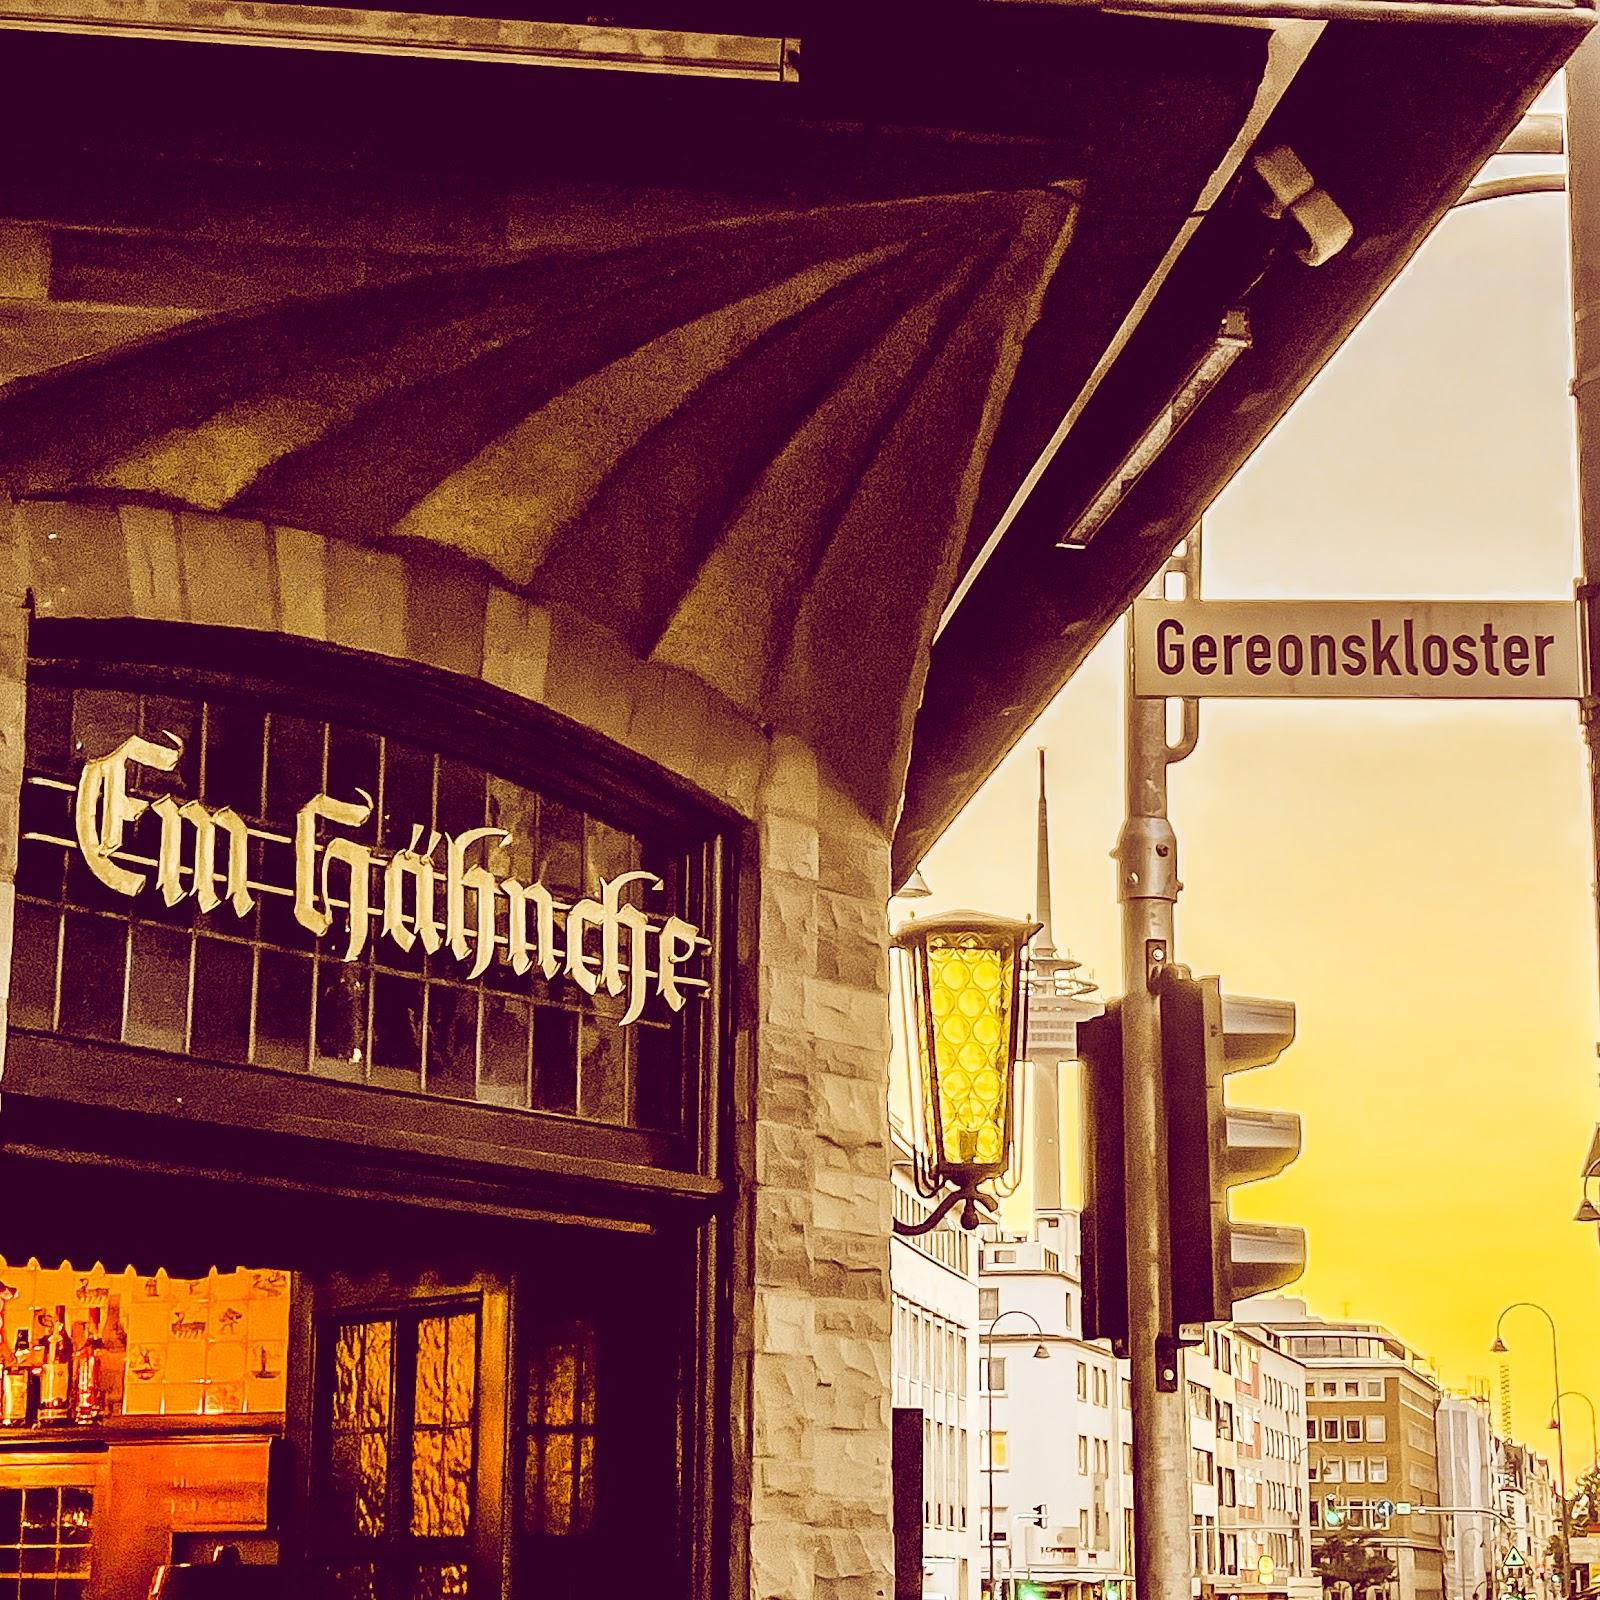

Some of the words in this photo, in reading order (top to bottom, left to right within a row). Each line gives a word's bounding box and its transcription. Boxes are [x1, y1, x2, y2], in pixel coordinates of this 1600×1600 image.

[1156, 618, 1554, 677] Gereonskloster
[75, 729, 256, 919] Em
[293, 787, 700, 1028] Hähnche
